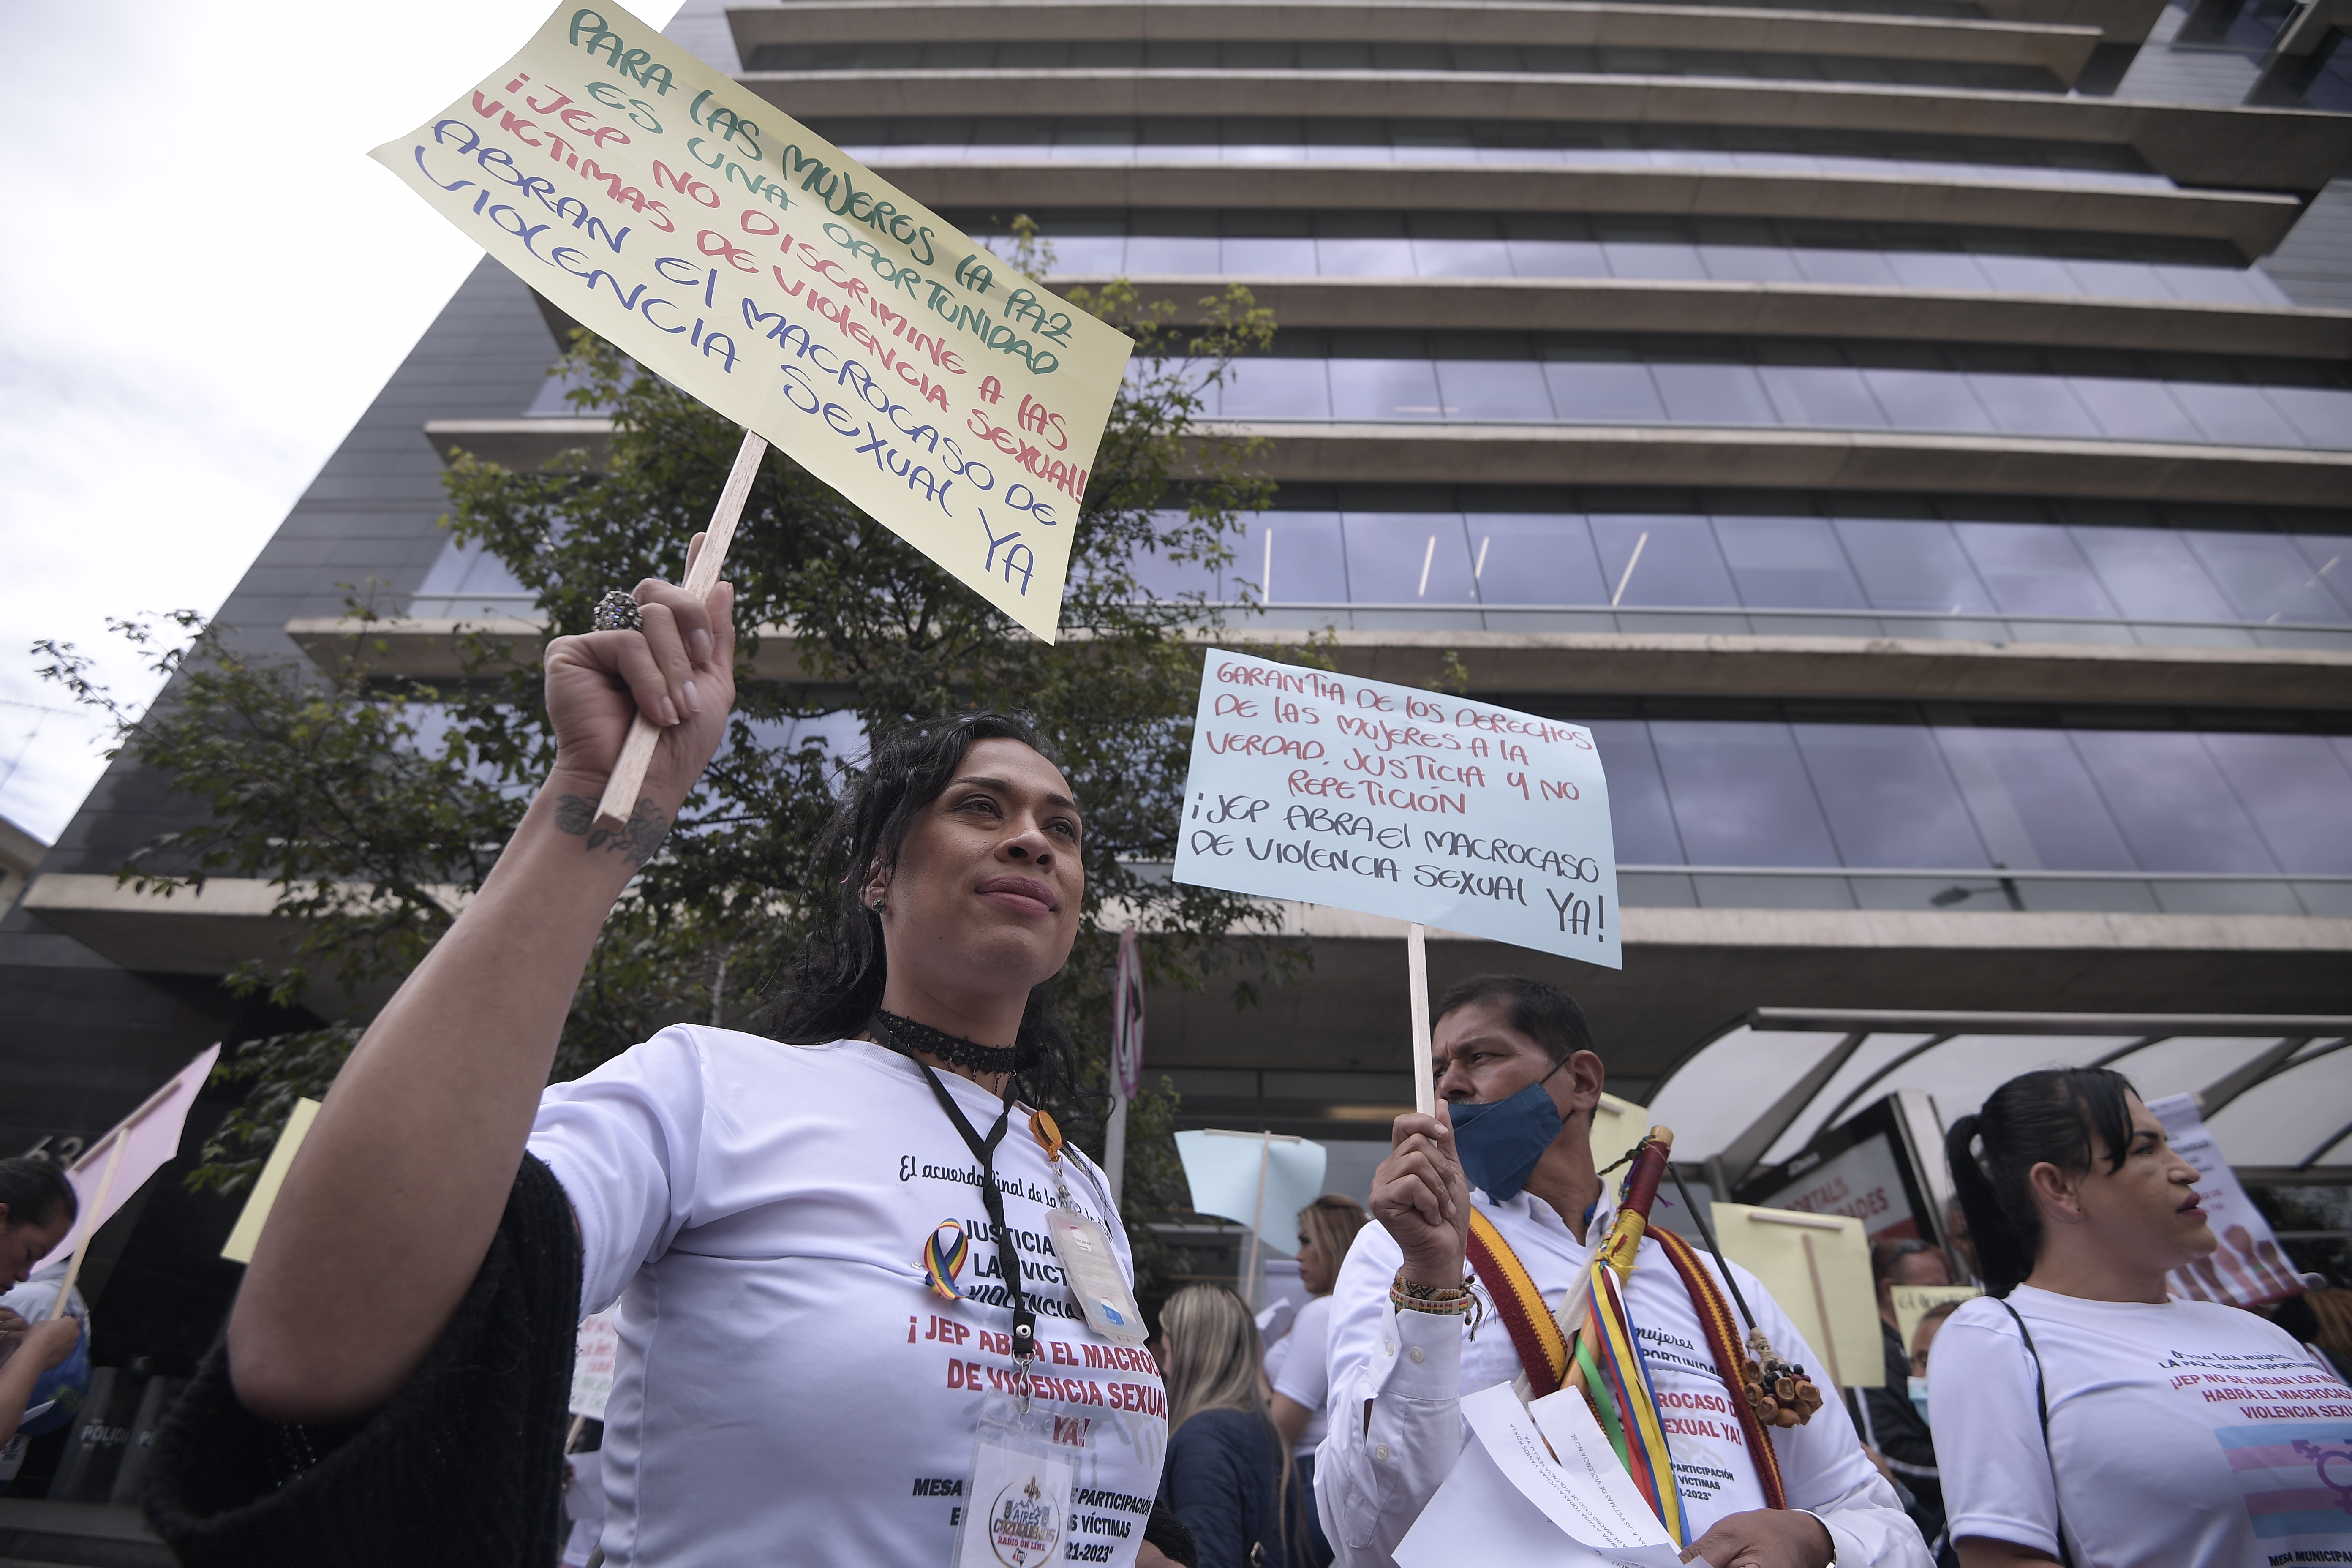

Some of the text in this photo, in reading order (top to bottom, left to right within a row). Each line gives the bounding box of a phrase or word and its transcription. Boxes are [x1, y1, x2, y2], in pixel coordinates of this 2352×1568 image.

[569, 8, 678, 96] PARA
[782, 144, 935, 265] MUJERES
[1004, 288, 1072, 348] PAZ
[585, 82, 1059, 375] ES UNA OPORTUNIDAD
[472, 90, 675, 233] VICTIMAS
[697, 230, 760, 273] DE
[773, 265, 949, 413] VIOLENCIA
[653, 160, 721, 209] NO
[740, 209, 967, 376] DISCRIMINE
[978, 375, 1005, 405] A
[431, 119, 631, 254] ABRAN
[742, 297, 994, 490] MACROCASO
[1004, 483, 1057, 526] DE
[415, 145, 1034, 597] VIOLENCIA SEXUAL YA
[1214, 693, 1258, 717] DE
[1337, 714, 1462, 751] MUJERES
[1467, 737, 1491, 757] A
[1356, 688, 1394, 712] DE
[1455, 708, 1592, 750] DERECHOS
[1344, 747, 1485, 787] JUSTICIA
[1540, 779, 1580, 801] NO
[1424, 830, 1599, 883] MACROCASO
[1191, 830, 1604, 942] DE VIOLENCIA SEXUAL YA!
[900, 1155, 917, 1181] El
[992, 1170, 1024, 1198] inal
[1028, 1182, 1043, 1204] de
[1044, 1187, 1057, 1209] la
[974, 1253, 1067, 1286] LA VICT
[979, 1330, 1045, 1362] ABA
[1049, 1342, 1080, 1366] EL
[1081, 1343, 1162, 1379] MACROC
[2158, 1359, 2180, 1368] LA
[947, 1358, 983, 1391] DE
[1106, 1382, 1167, 1421] SEXUAL
[2201, 1374, 2226, 1383] NO
[2226, 1375, 2247, 1384] SE
[2244, 1376, 2295, 1385] HAGAN
[2290, 1375, 2320, 1384] LOS
[2201, 1386, 2258, 1402] HABRÁ
[2256, 1389, 2278, 1400] EL
[2239, 1405, 2321, 1419] VIOLENCIA
[1054, 1415, 1092, 1447] YA!
[1509, 1423, 1516, 1431] LA
[1514, 1432, 1524, 1445] POR
[1570, 1433, 1578, 1441] SE
[1663, 1419, 1742, 1446] EXUAL YA!
[1522, 1446, 1538, 1468] VAMOS
[1529, 1446, 1546, 1467] SEXUAL
[1573, 1441, 1582, 1452] NO
[1545, 1467, 1571, 1493] VIOLENCIA
[1581, 1453, 1602, 1485] VIOLENCIA
[1599, 1485, 1607, 1494] DE
[1678, 1474, 1720, 1490] VÍCTIMAS
[912, 1479, 962, 1496] MESA
[1078, 1488, 1152, 1516] PARTICIPACIÓN
[1563, 1495, 1581, 1513] TODAS
[1579, 1502, 1593, 1516] CASO
[1605, 1494, 1625, 1522] VICTIMAS
[1013, 1509, 1042, 1526] AIRES
[1082, 1511, 1131, 1538] VÍCTIMAS
[1581, 1512, 1601, 1532] ARRIBA
[1592, 1516, 1614, 1536] MACRO
[1624, 1522, 1634, 1533] LAS
[998, 1535, 1045, 1551] RADIO ON LINE
[1613, 1535, 1622, 1544] DE
[1068, 1542, 1114, 1563] 21-2023"
[2268, 1552, 2294, 1566] MESA
